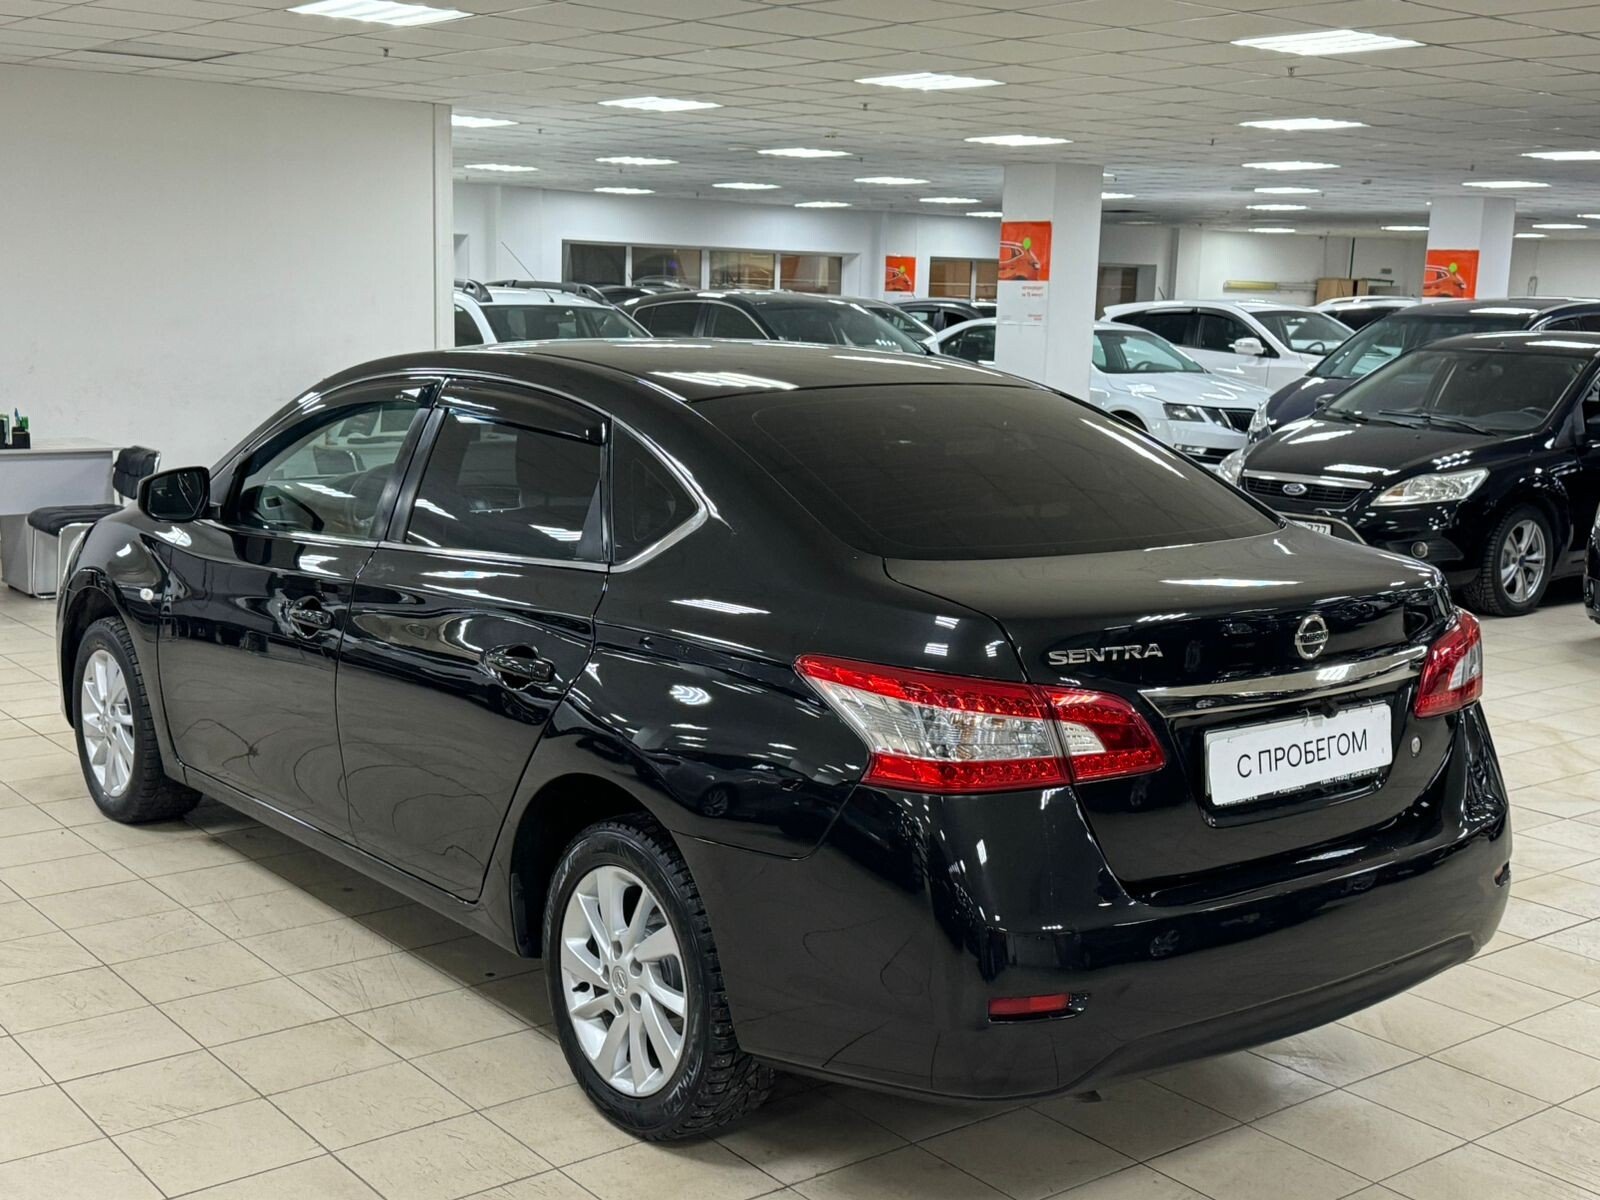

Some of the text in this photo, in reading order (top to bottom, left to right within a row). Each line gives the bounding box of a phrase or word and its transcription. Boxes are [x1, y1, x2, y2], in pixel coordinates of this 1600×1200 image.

[1048, 643, 1163, 666] SENTRA
[1237, 728, 1368, 778] С ПРОБЕГОМ
